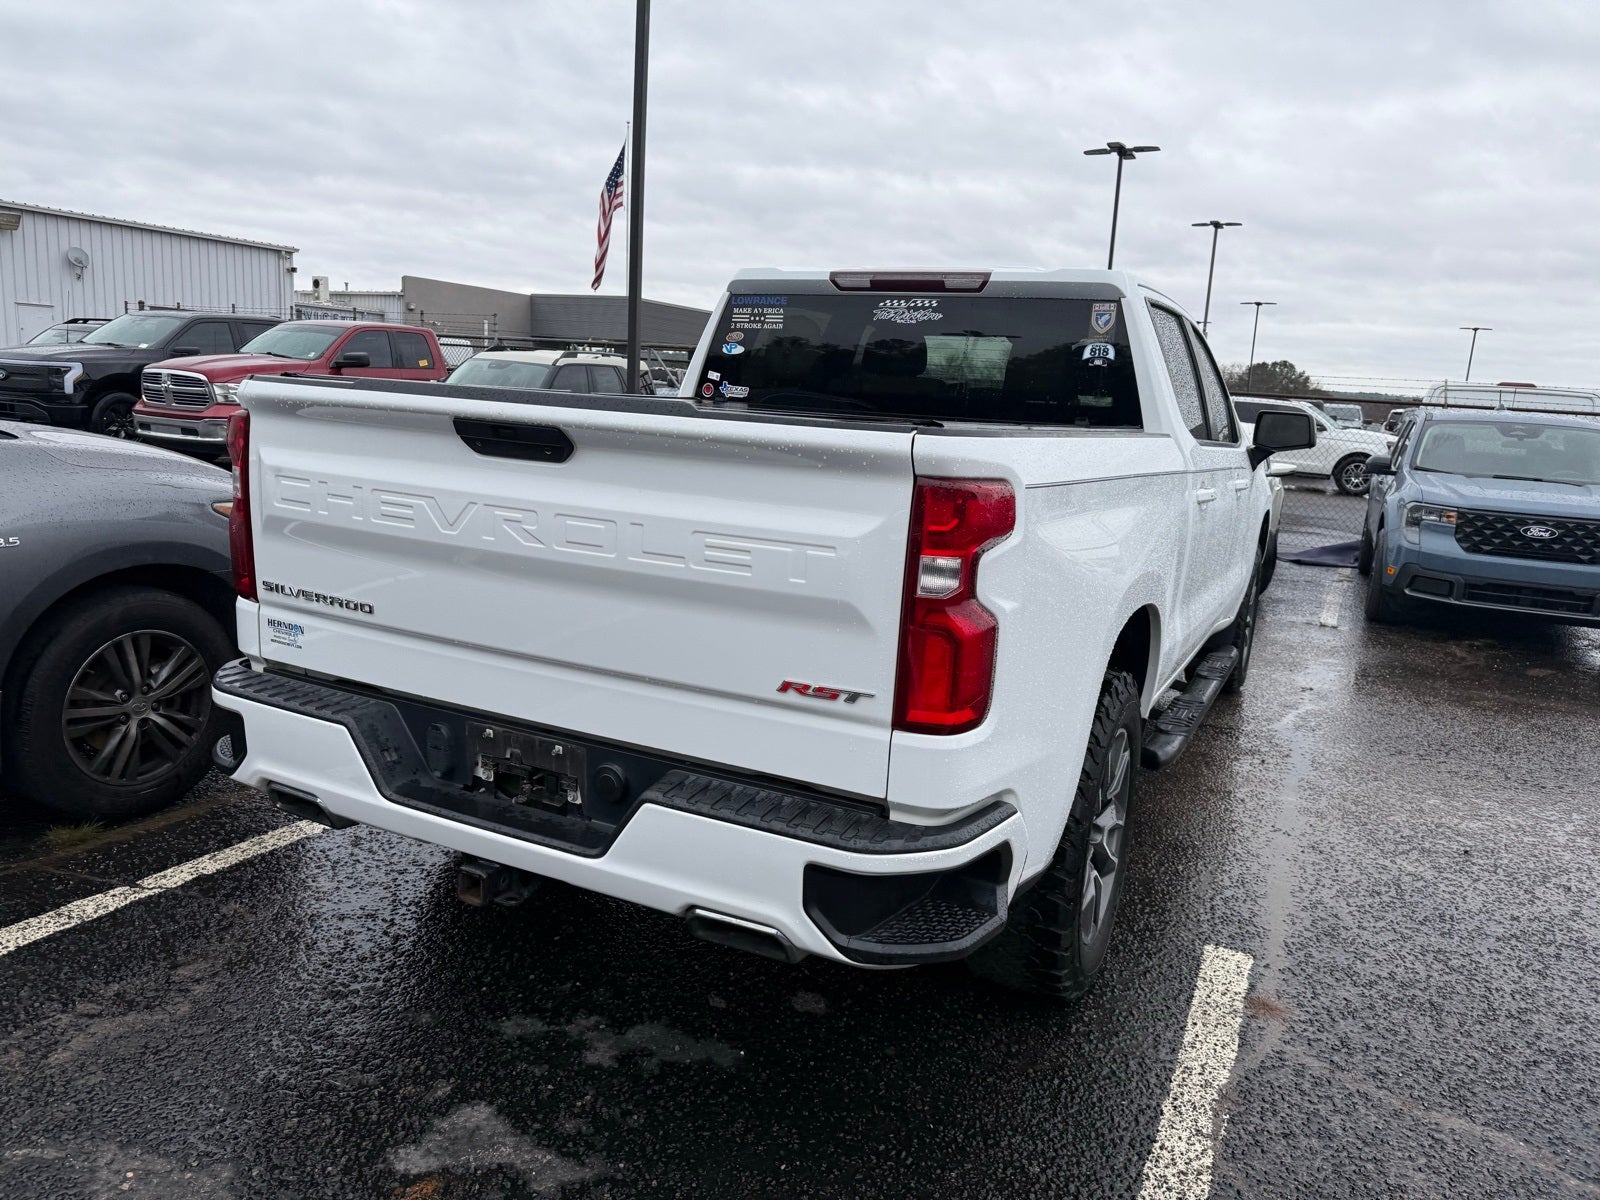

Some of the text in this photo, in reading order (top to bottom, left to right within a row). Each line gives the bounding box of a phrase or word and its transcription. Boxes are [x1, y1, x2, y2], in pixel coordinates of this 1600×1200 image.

[731, 296, 788, 305] LOWRANCE
[724, 343, 738, 353] VP
[1089, 347, 1110, 357] 818
[273, 473, 838, 584] CHEVROLET
[262, 580, 375, 614] SILVERADO
[267, 618, 305, 635] HERNDON
[776, 680, 876, 704] RST
